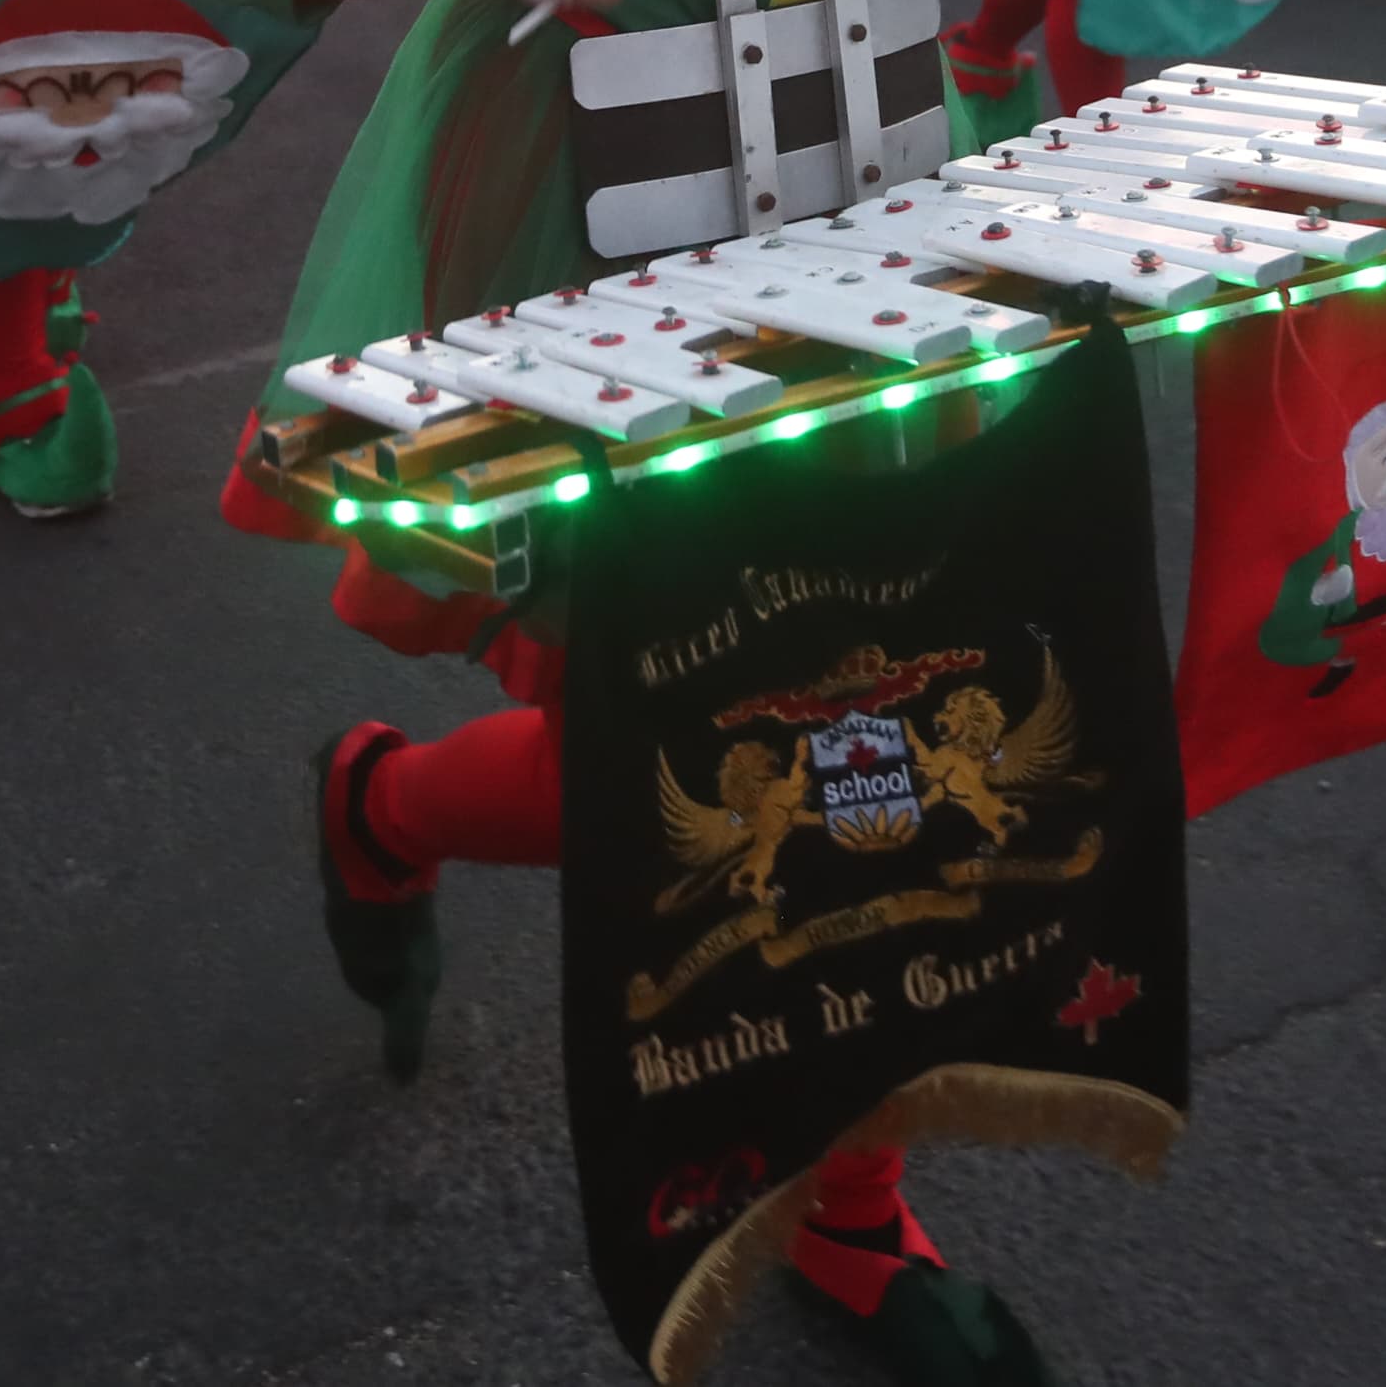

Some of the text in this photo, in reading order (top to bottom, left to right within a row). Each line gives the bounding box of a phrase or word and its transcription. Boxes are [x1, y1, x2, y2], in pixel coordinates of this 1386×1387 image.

[822, 762, 912, 805] school
[628, 918, 1066, 1101] Banda de Guerra
